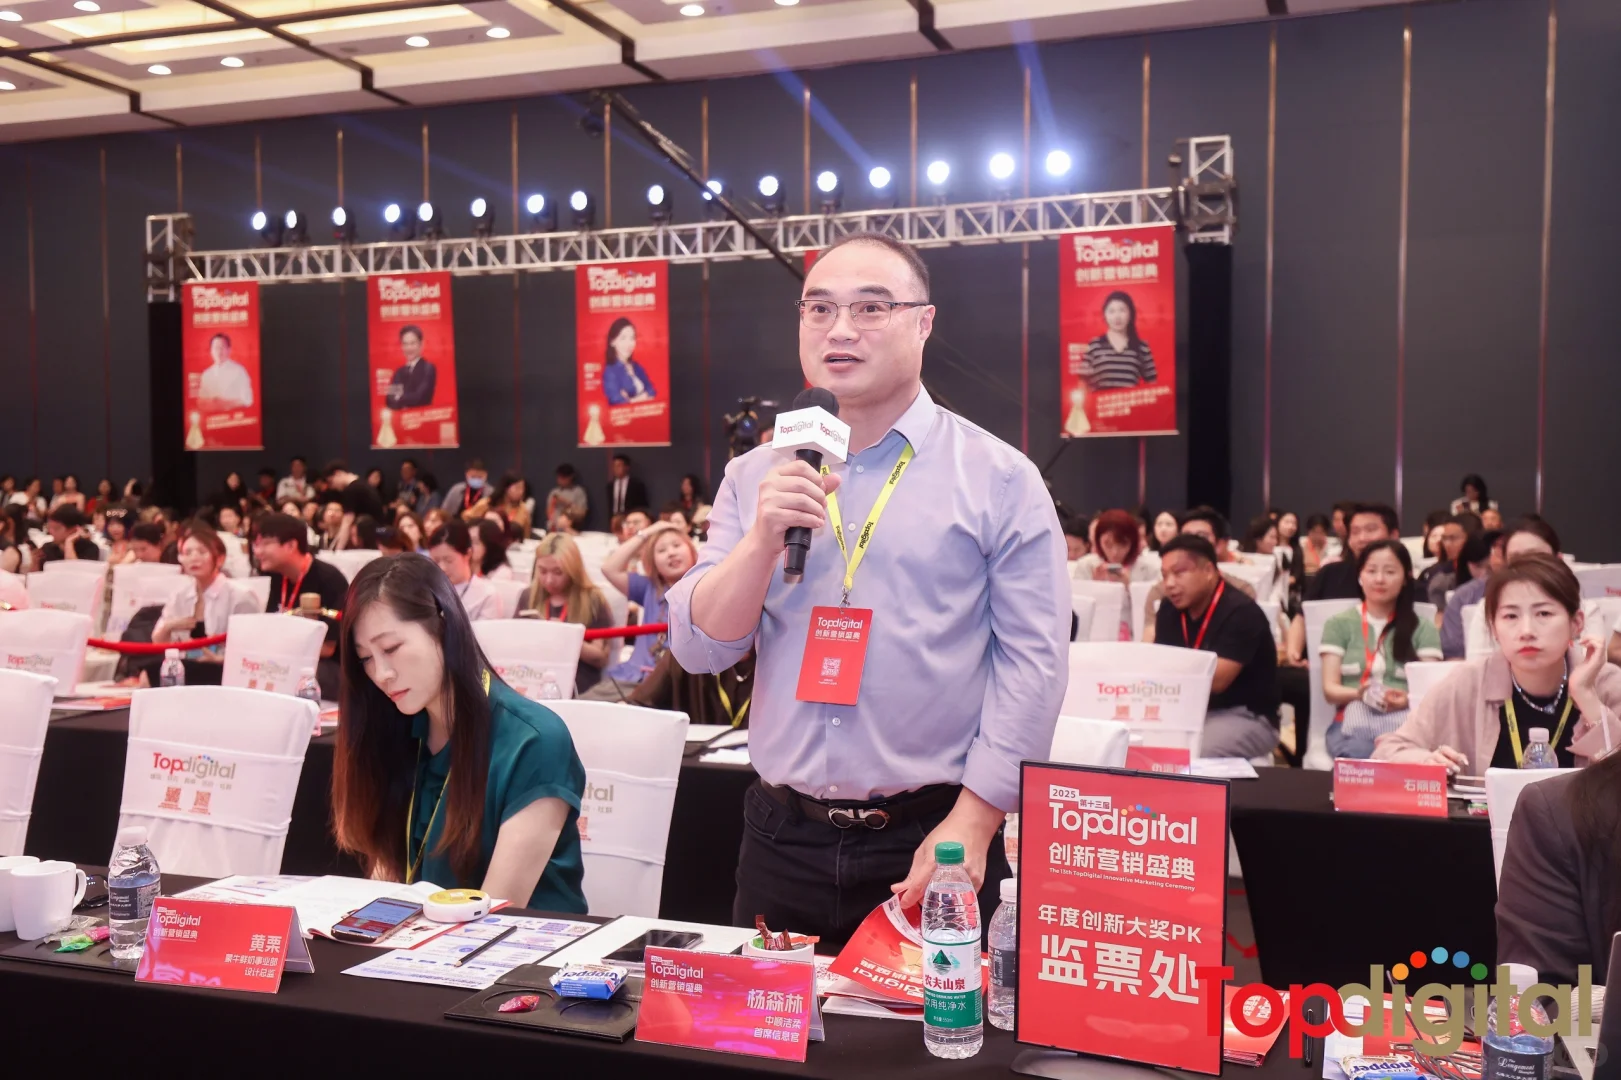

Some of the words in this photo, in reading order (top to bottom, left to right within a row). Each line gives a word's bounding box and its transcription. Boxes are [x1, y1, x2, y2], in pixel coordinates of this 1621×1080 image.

[779, 420, 814, 434] Topdigital
[819, 422, 847, 446] Topdigital
[817, 616, 864, 631] Topdigital
[1096, 680, 1182, 698] Topdigital
[153, 752, 236, 780] Topdigital
[1052, 788, 1077, 799] 2025
[1079, 798, 1111, 811] 第十三届
[1048, 801, 1198, 846] Topdigital
[1048, 841, 1196, 882] 创新营销盛典
[1049, 867, 1060, 875] The
[1073, 870, 1103, 880] TopDigital
[1103, 874, 1134, 883] Innovative
[1134, 878, 1165, 888] Marketing
[1165, 882, 1196, 892] Ceremony
[156, 912, 202, 928] Topdigital
[1038, 903, 1203, 944] 年度创新大奖PK
[244, 967, 276, 979] 设计总监
[651, 962, 704, 980] Topdigital
[1037, 934, 1200, 1005] 监票处
[650, 978, 704, 994] 创新营销盛典
[852, 966, 924, 993] digital
[925, 975, 966, 990] 农夫山泉
[747, 988, 803, 1015] 杨森林
[764, 1016, 802, 1029] 中顺洁柔
[753, 1027, 800, 1043] 首席信息官
